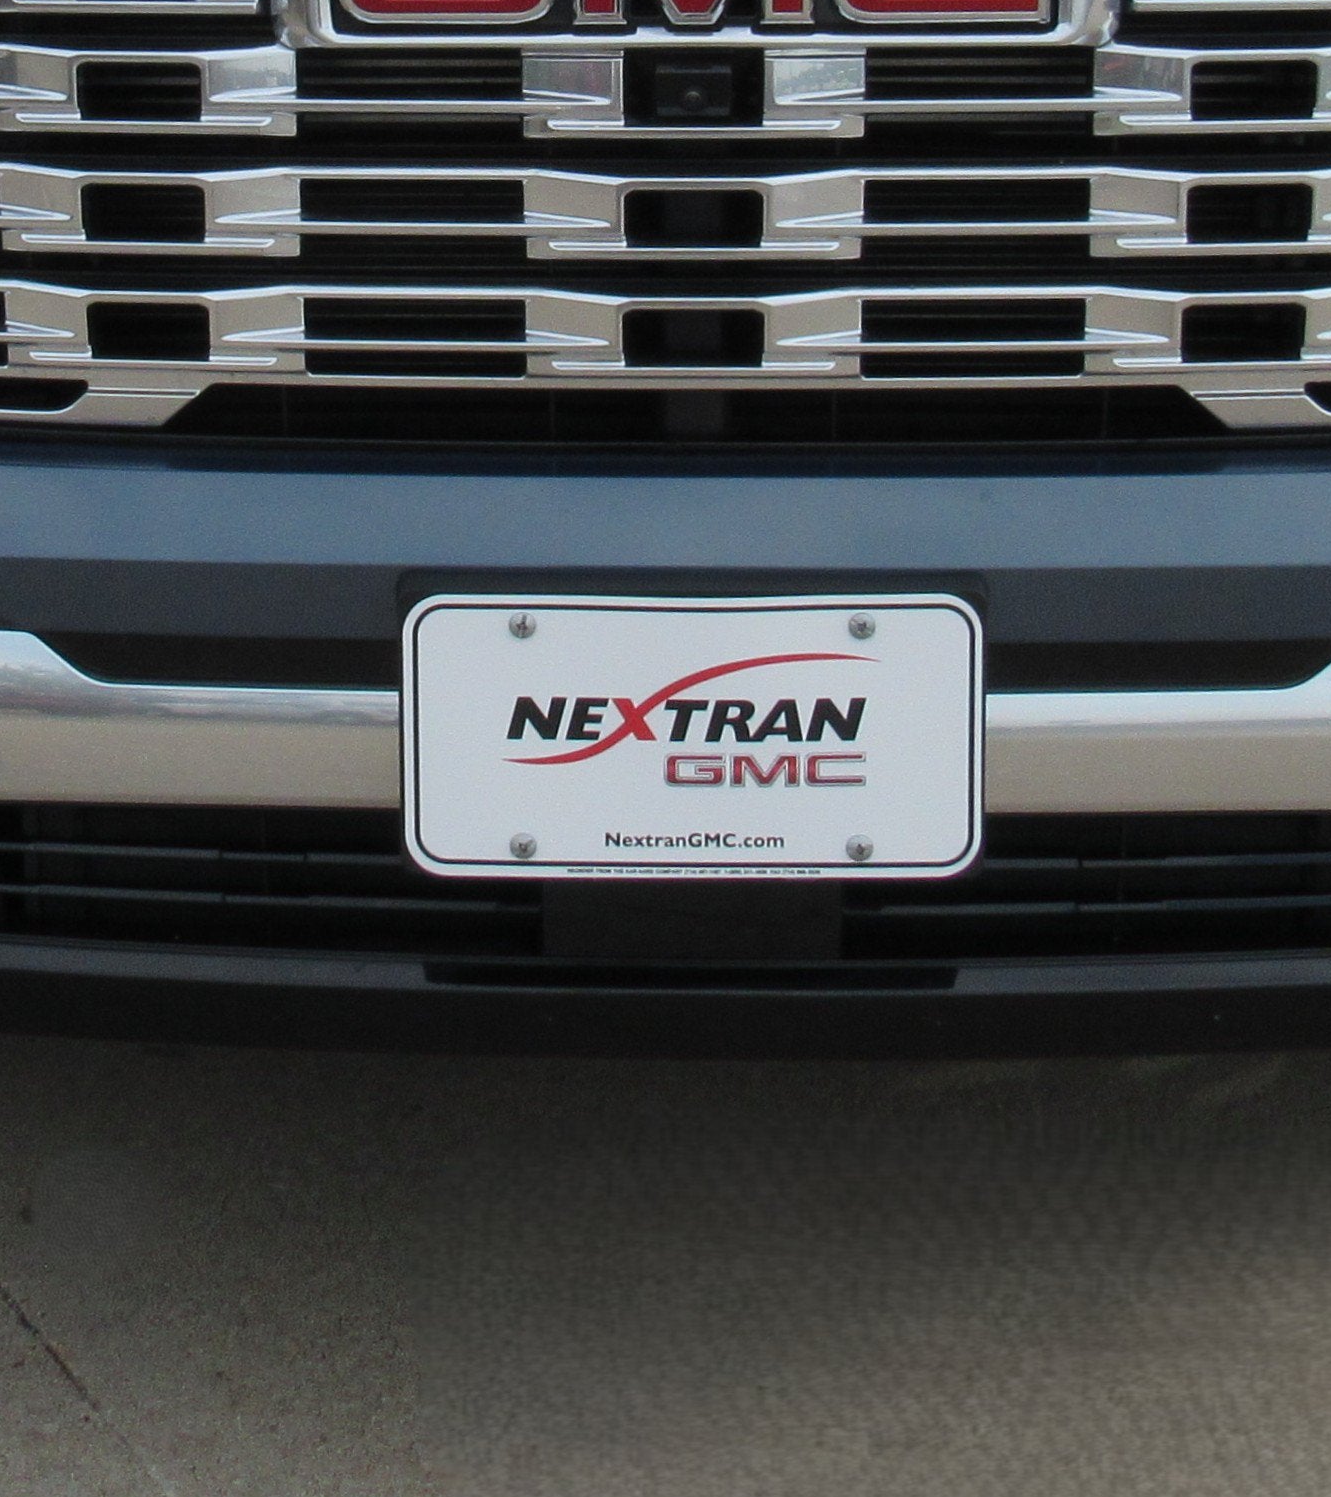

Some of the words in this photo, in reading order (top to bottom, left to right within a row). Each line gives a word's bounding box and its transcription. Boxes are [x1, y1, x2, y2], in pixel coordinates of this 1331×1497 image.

[505, 695, 868, 743] NEXTRAN
[663, 752, 867, 788] GMC
[604, 831, 786, 850] NextranGMC.com
